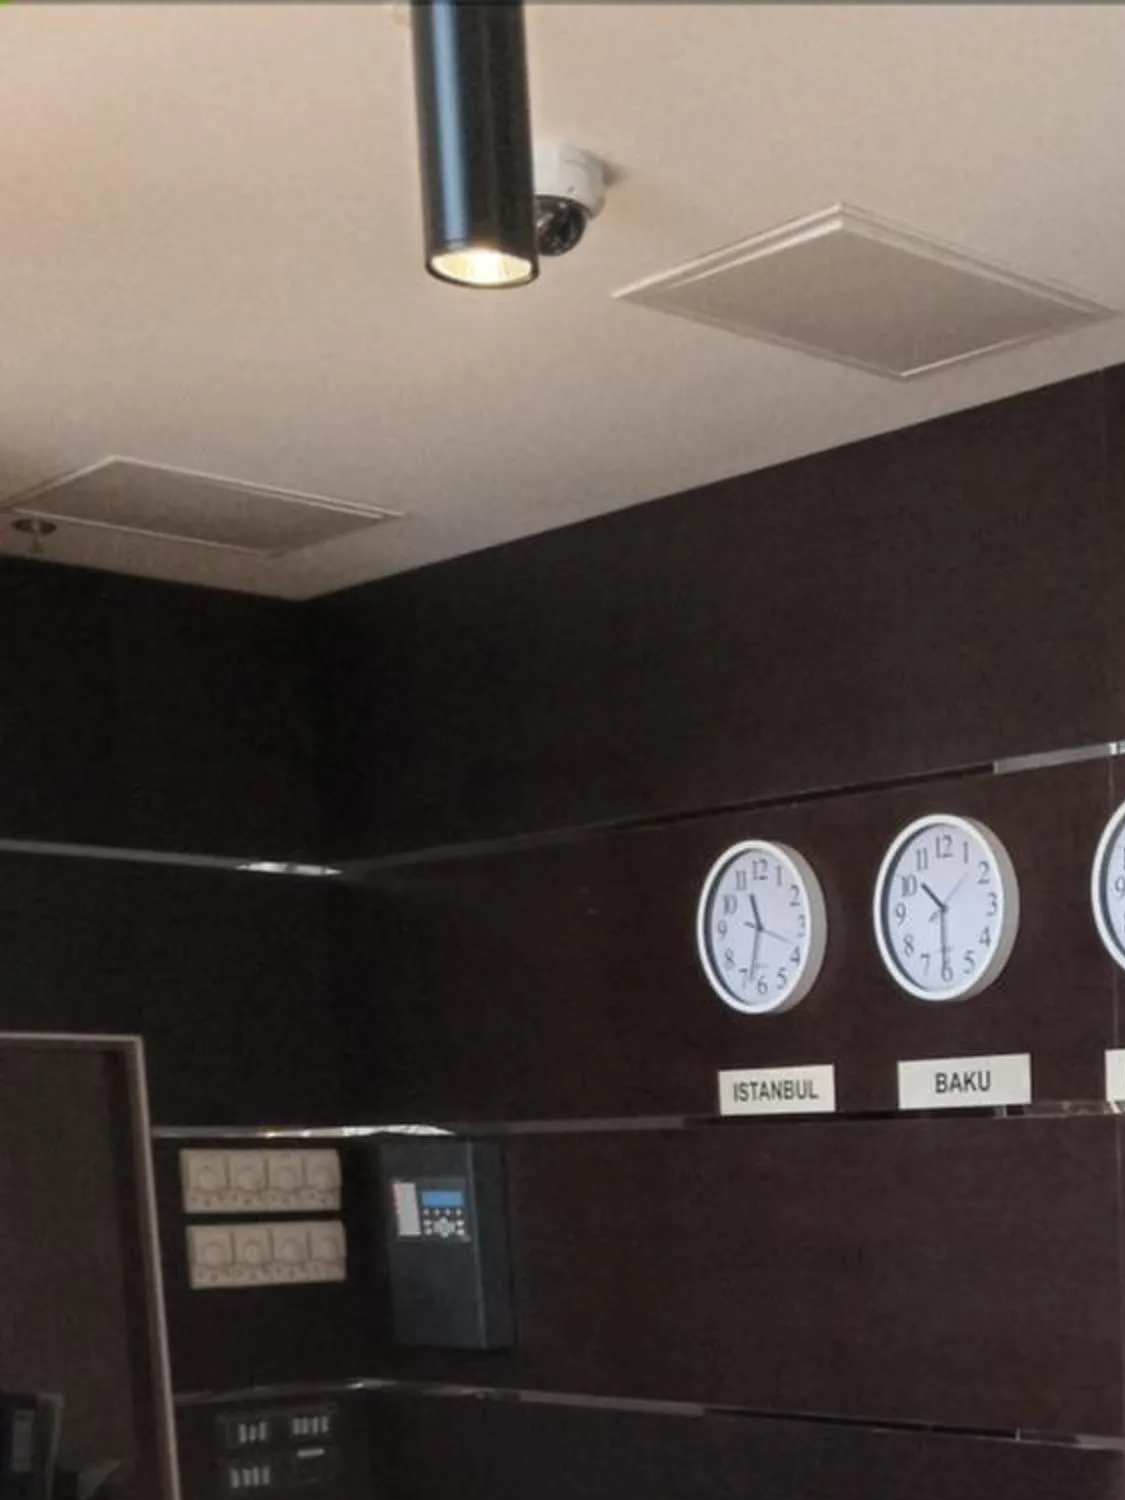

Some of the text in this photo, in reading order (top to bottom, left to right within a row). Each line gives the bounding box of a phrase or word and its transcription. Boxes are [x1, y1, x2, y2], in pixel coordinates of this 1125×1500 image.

[936, 835, 952, 858] 12
[752, 858, 768, 880] 12
[917, 848, 928, 871] 11
[736, 870, 747, 891] 11
[978, 861, 990, 884] 2
[789, 884, 800, 907] 2
[901, 874, 917, 897] 10
[723, 895, 737, 915] 10
[896, 903, 906, 925] 9
[987, 892, 998, 917] 3
[718, 920, 727, 940] 9
[979, 927, 991, 948] 4
[903, 933, 914, 957] 8
[724, 948, 735, 969] 8
[790, 947, 800, 966] 4
[921, 954, 930, 975] 7
[964, 950, 976, 974] 5
[777, 967, 787, 989] 5
[941, 960, 953, 982] 6
[757, 976, 768, 995] 6
[733, 1079, 819, 1102] ISTANBUL
[934, 1070, 992, 1094] BAKU
